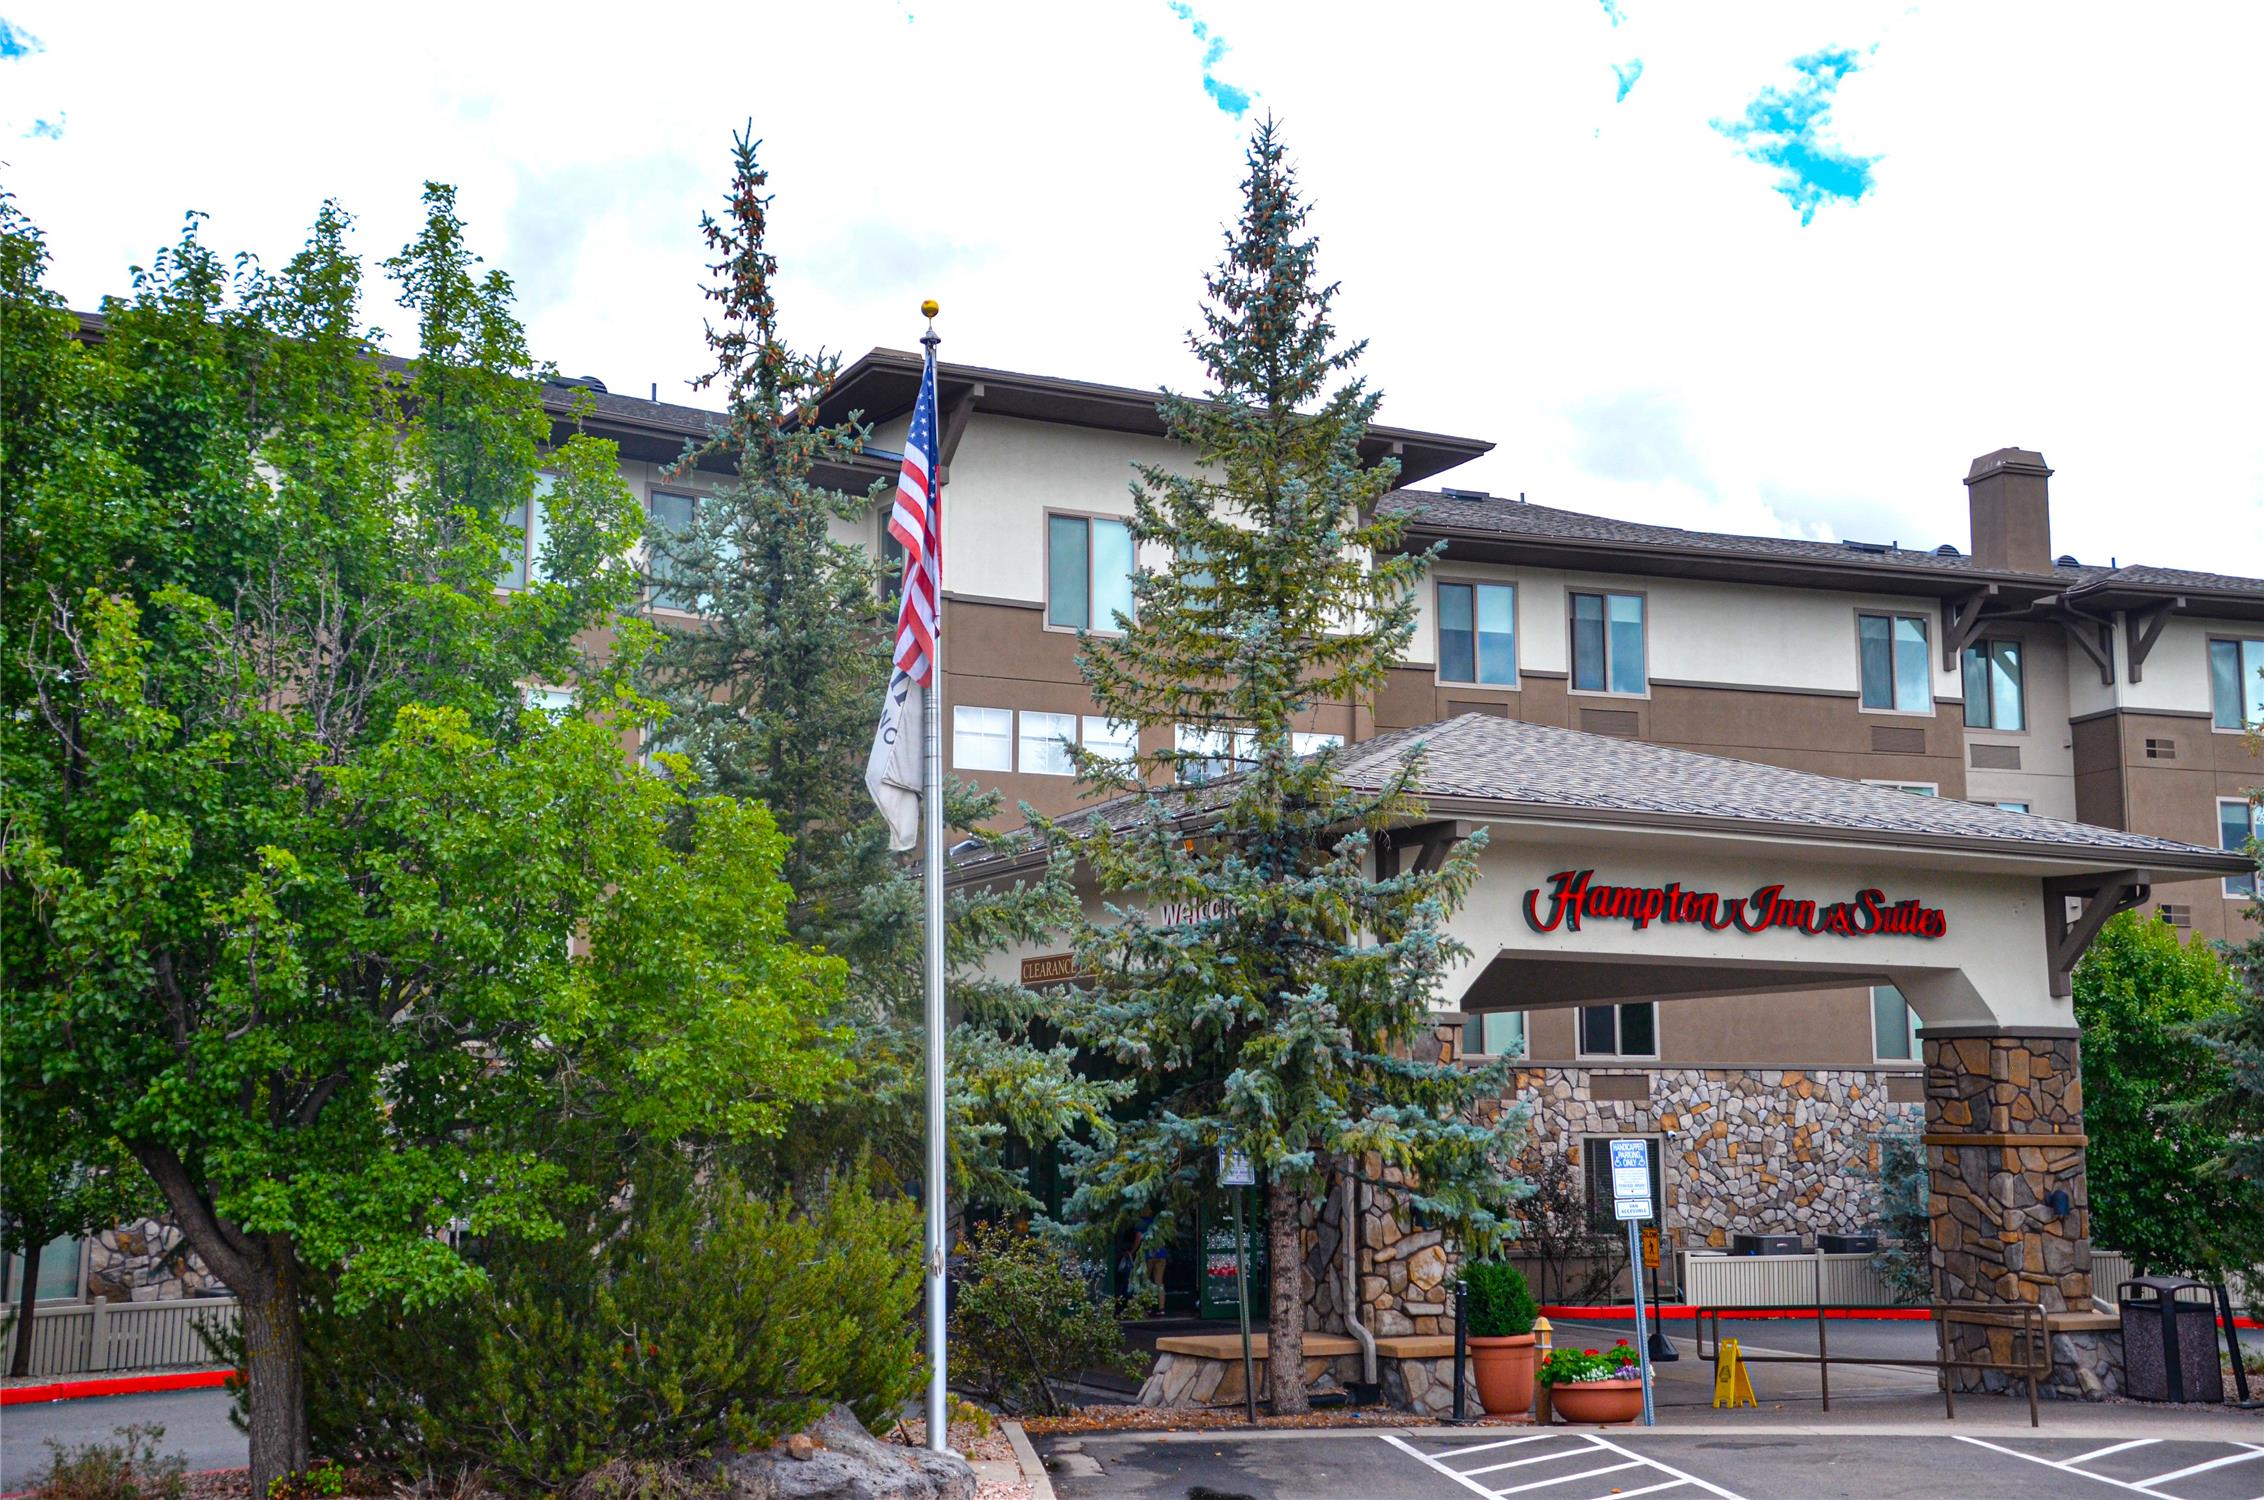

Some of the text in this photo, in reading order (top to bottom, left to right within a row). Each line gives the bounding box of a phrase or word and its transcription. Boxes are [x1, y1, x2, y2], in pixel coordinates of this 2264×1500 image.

[1160, 896, 1237, 926] Welco
[1523, 869, 1947, 938] Hampton Inn & Suites
[1023, 958, 1077, 979] CLEARANCE
[1613, 1143, 1644, 1152] HANDICAPPED
[1618, 1151, 1641, 1159] PARKING
[1623, 1158, 1637, 1167] ONLY
